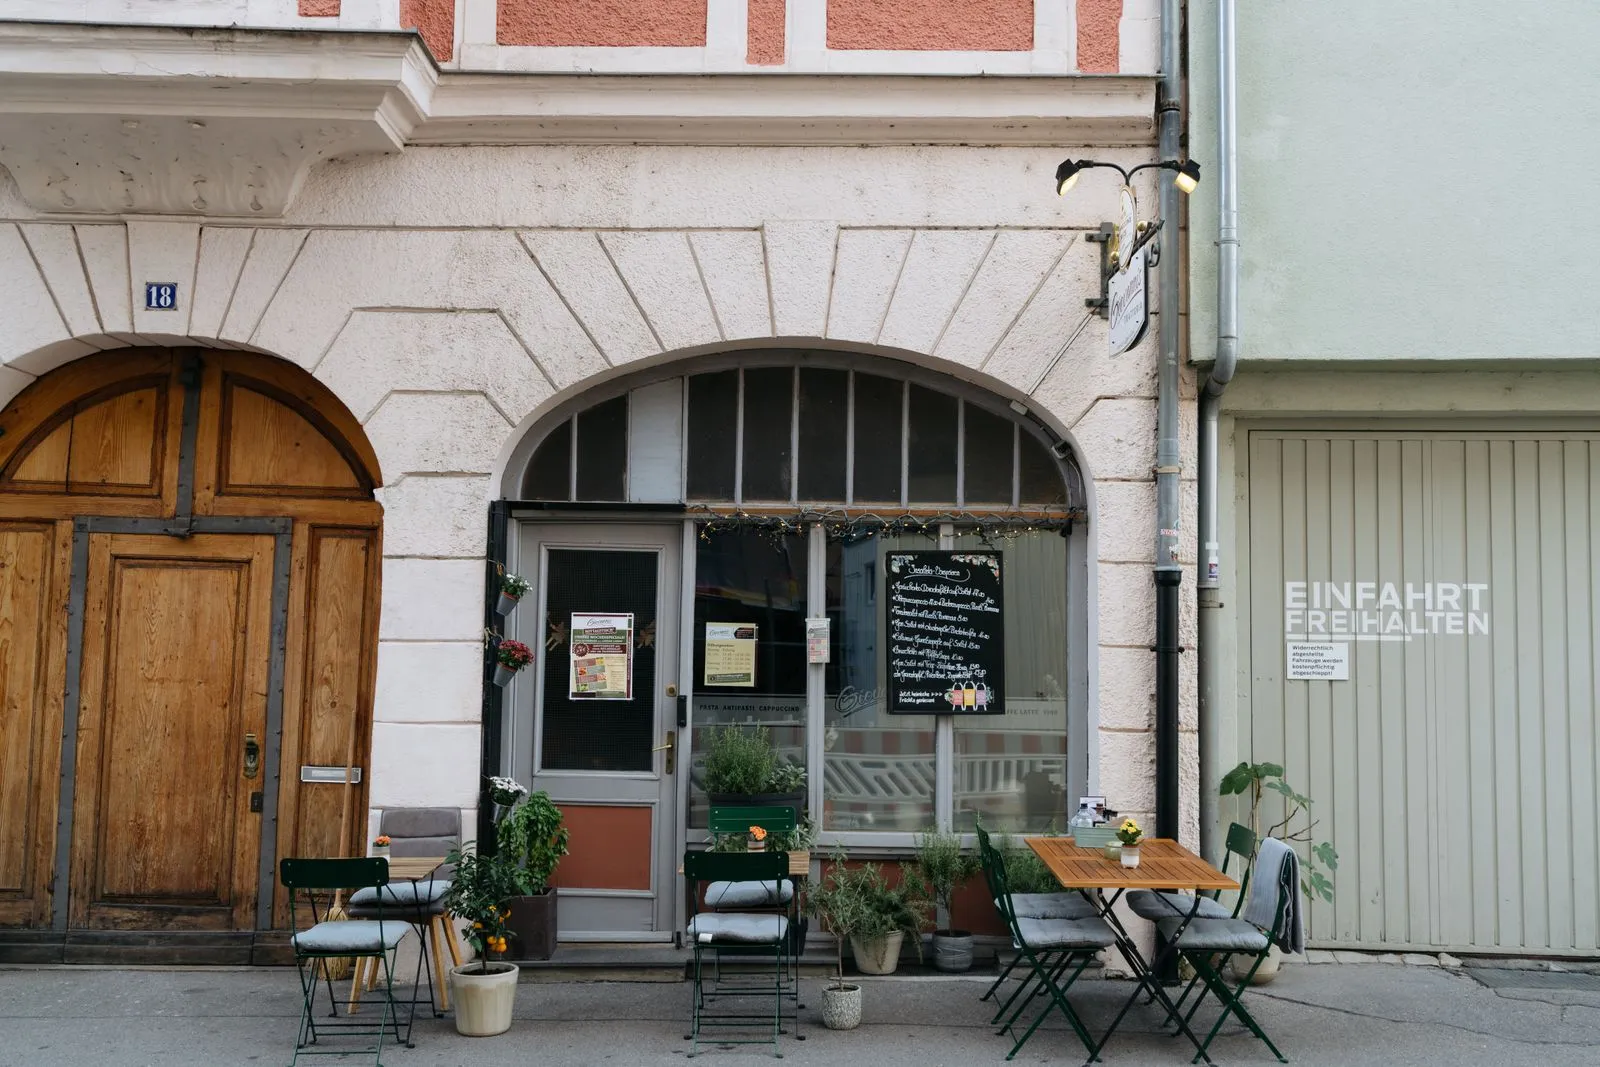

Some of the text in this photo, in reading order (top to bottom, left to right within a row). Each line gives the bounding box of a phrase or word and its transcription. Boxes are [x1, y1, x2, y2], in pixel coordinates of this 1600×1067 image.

[149, 286, 171, 307] 18
[1286, 582, 1488, 611] EINFAHRT
[1286, 610, 1488, 635] FREIHALTEN
